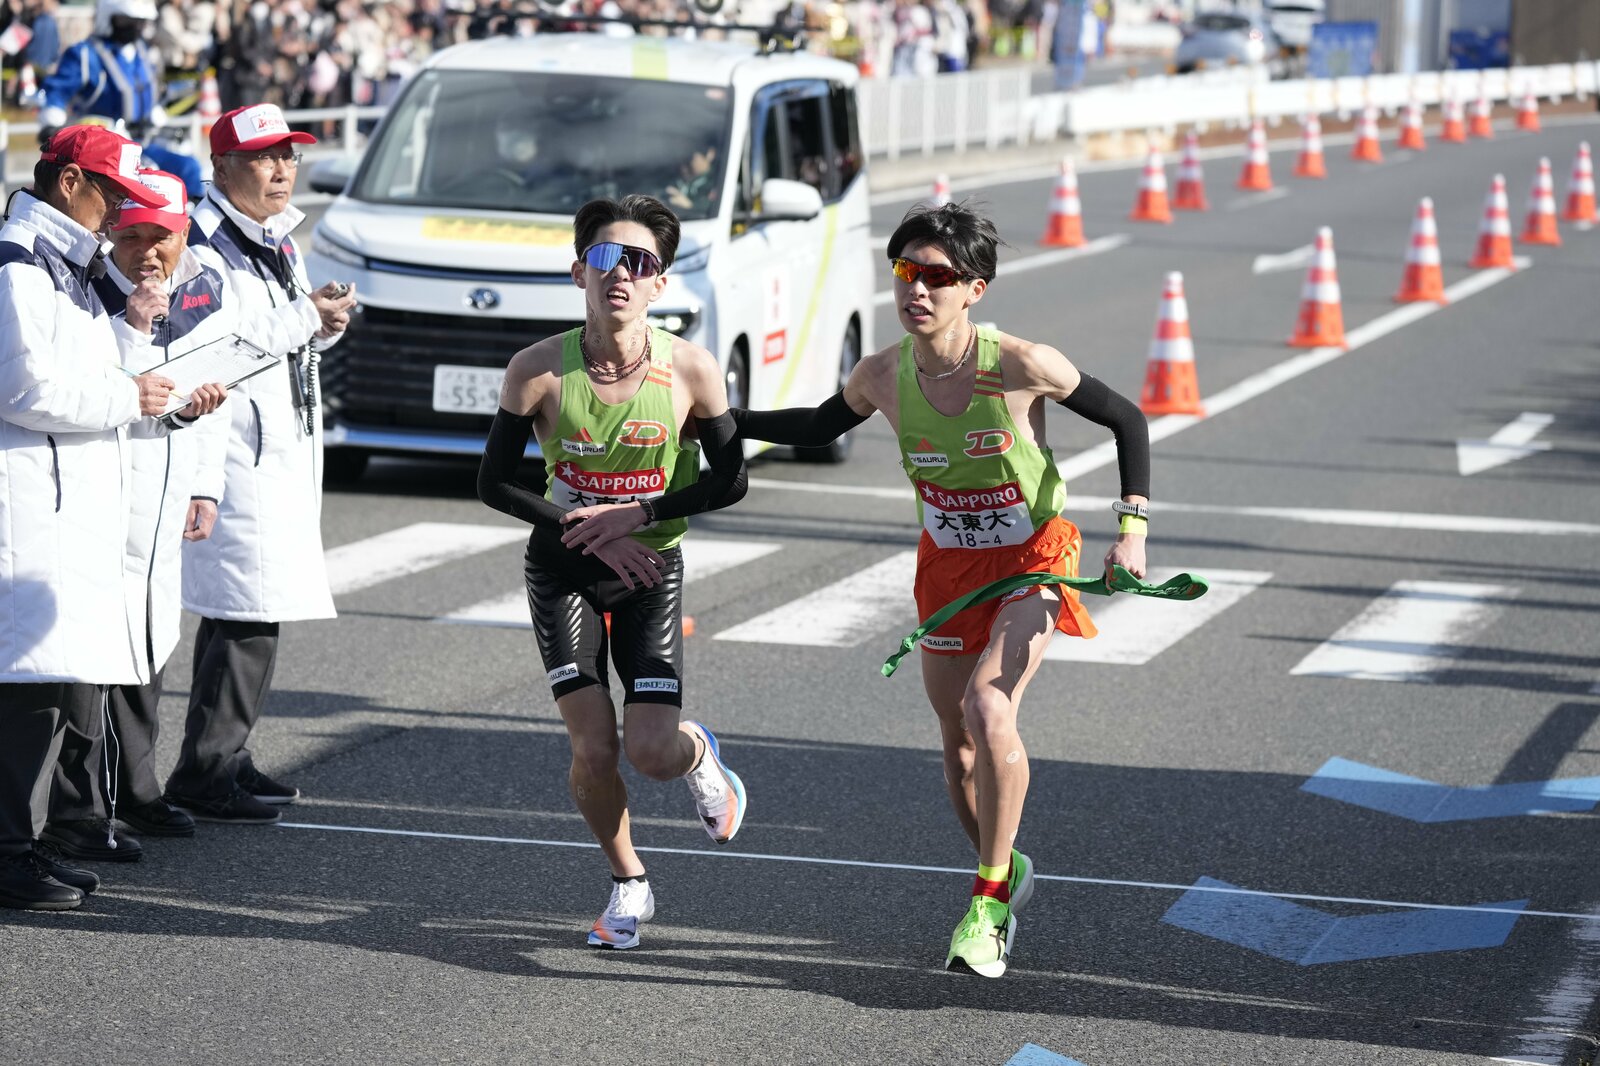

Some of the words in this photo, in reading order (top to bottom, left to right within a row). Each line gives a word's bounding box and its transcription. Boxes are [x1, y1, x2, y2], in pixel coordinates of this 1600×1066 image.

[617, 421, 668, 447] D
[963, 430, 1014, 458] D
[577, 474, 660, 490] SAPPORO
[936, 487, 1018, 508] SAPPORO
[935, 511, 1012, 532] 大東大
